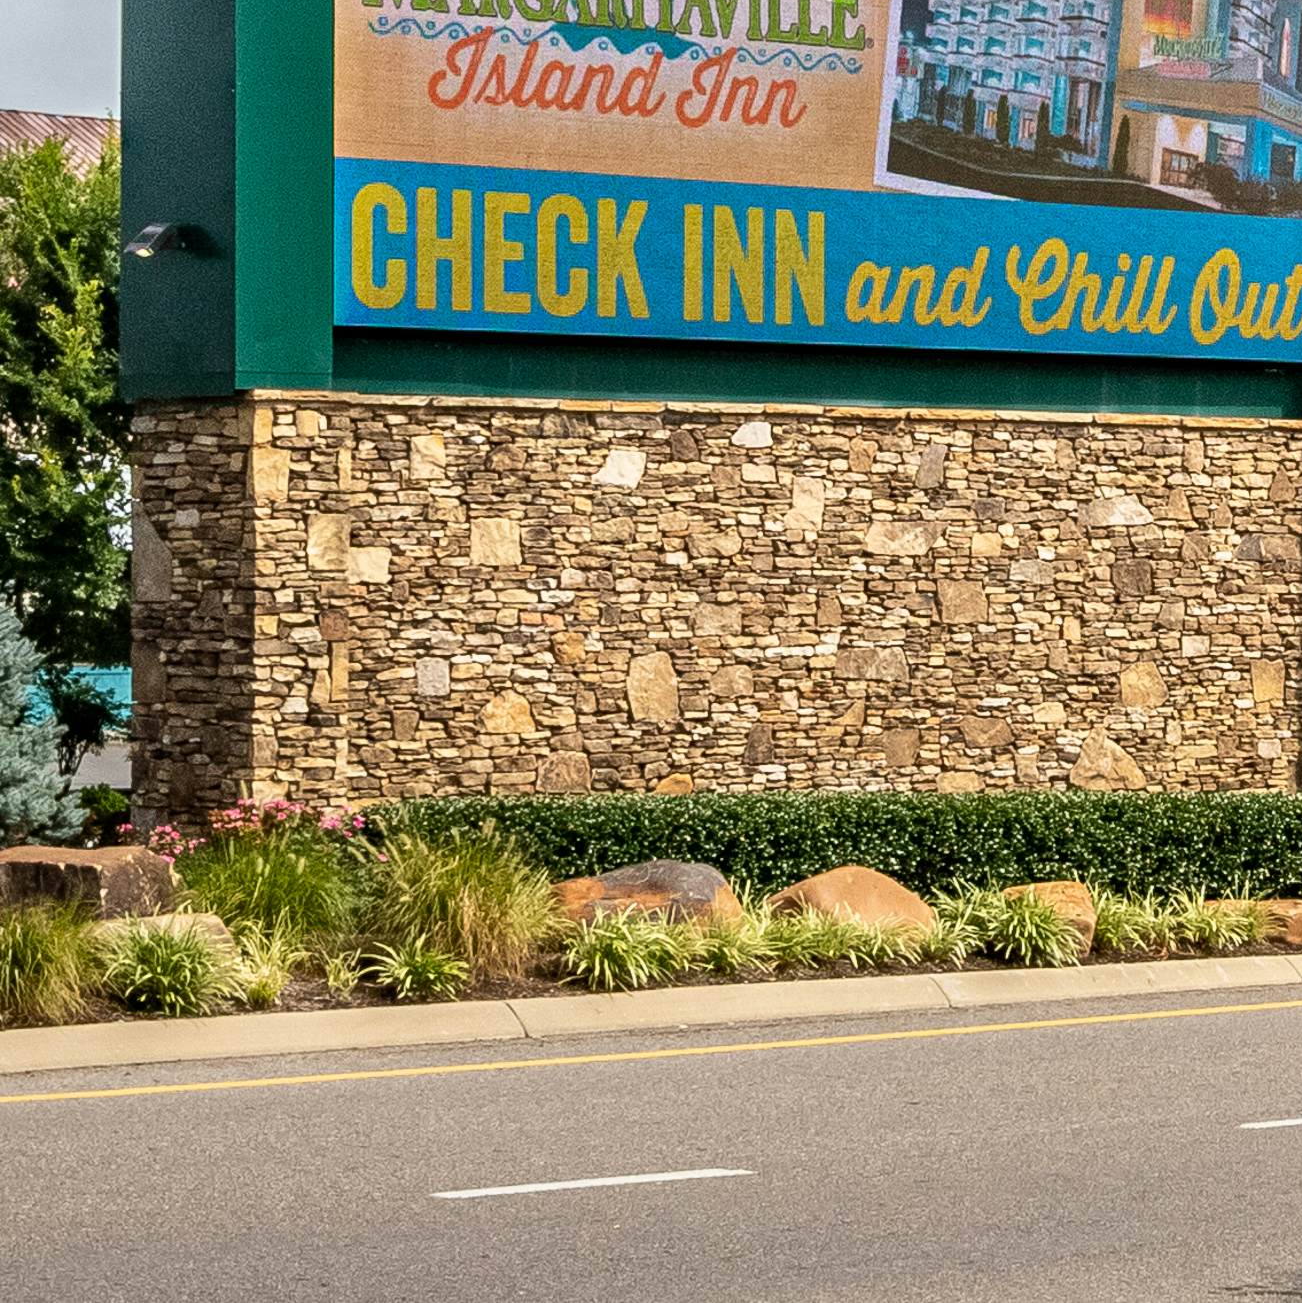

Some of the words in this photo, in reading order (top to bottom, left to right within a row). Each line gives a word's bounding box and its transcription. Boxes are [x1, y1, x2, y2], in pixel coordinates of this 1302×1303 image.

[427, 26, 668, 112] Island
[675, 46, 809, 129] Inn
[350, 182, 650, 320] CHECK
[683, 203, 826, 326] INN
[844, 244, 993, 328] and
[1005, 236, 1177, 337] Chill
